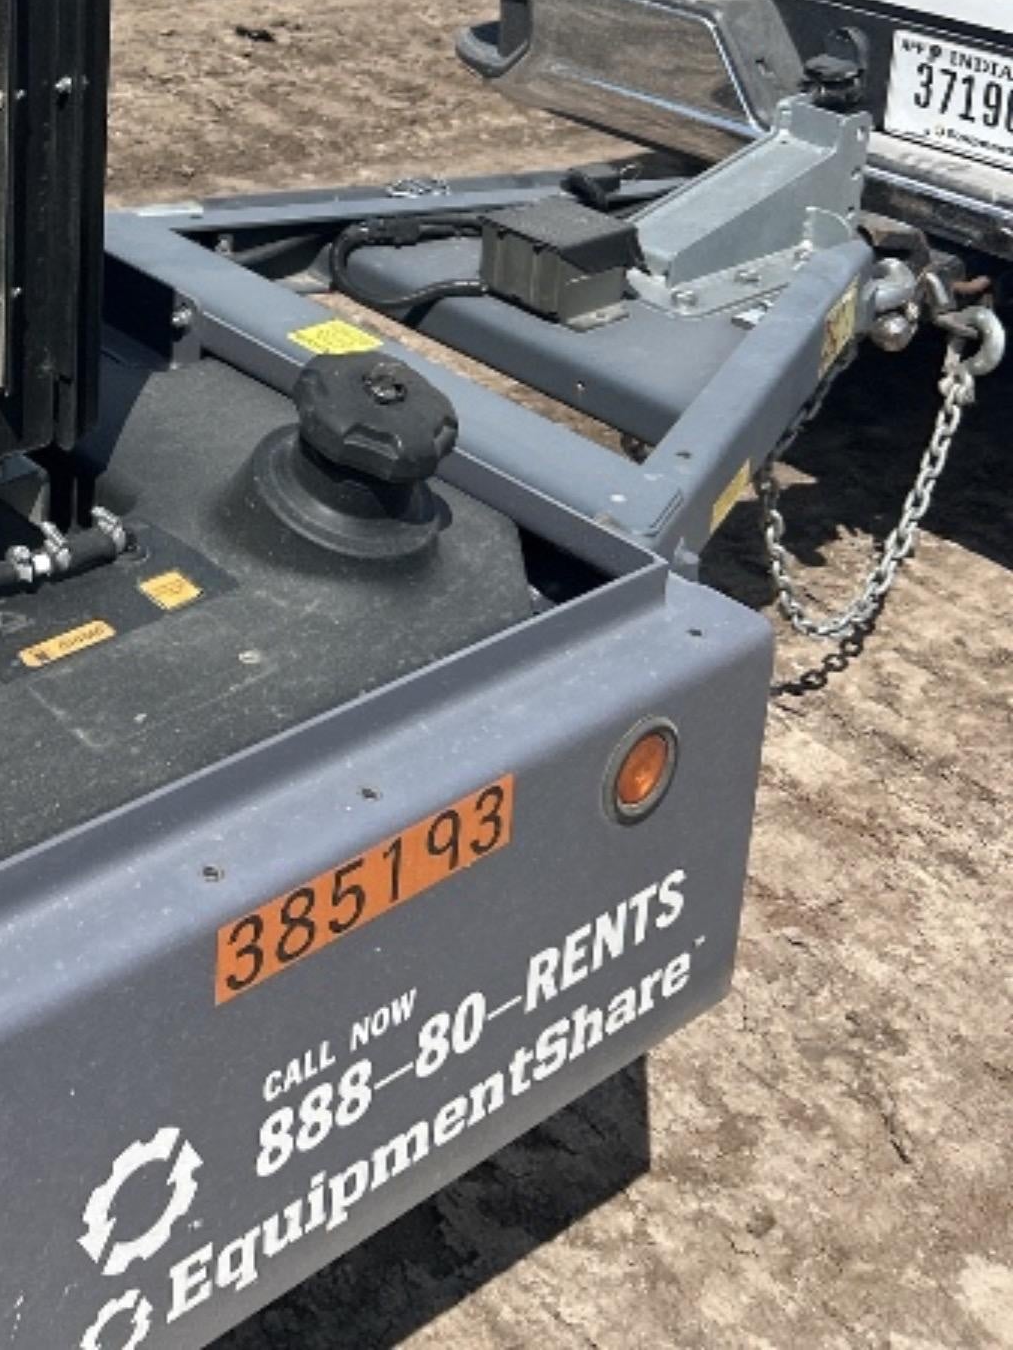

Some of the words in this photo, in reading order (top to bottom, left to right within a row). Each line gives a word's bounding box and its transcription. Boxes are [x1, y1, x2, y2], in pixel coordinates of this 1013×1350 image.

[226, 785, 505, 992] 385193
[166, 952, 691, 1324] EquipmentShare
[263, 1041, 336, 1102] CALL
[348, 987, 418, 1052] NOW
